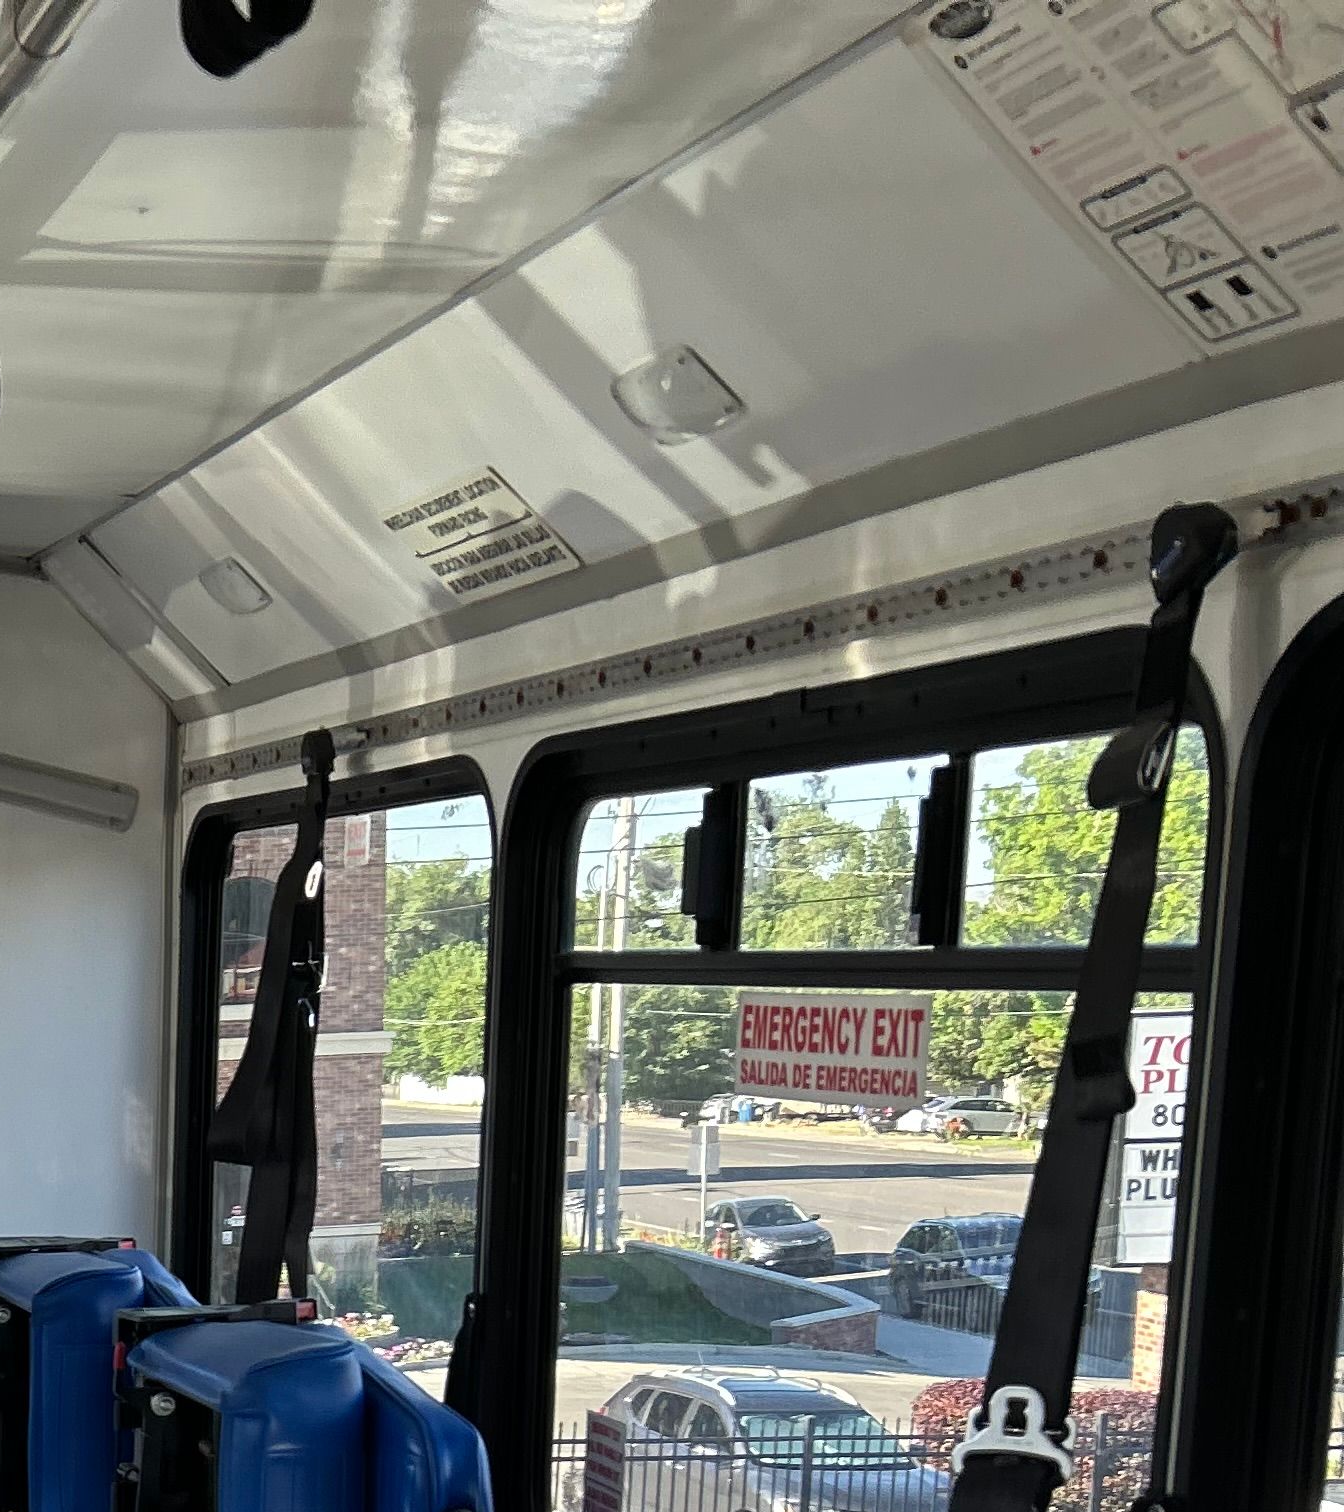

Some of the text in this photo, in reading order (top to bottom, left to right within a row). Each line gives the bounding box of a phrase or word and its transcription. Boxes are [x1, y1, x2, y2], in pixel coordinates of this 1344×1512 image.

[740, 1004, 925, 1058] EMERGENCY EXIT
[740, 1058, 918, 1099] SALIDA DE EMERGENCIA
